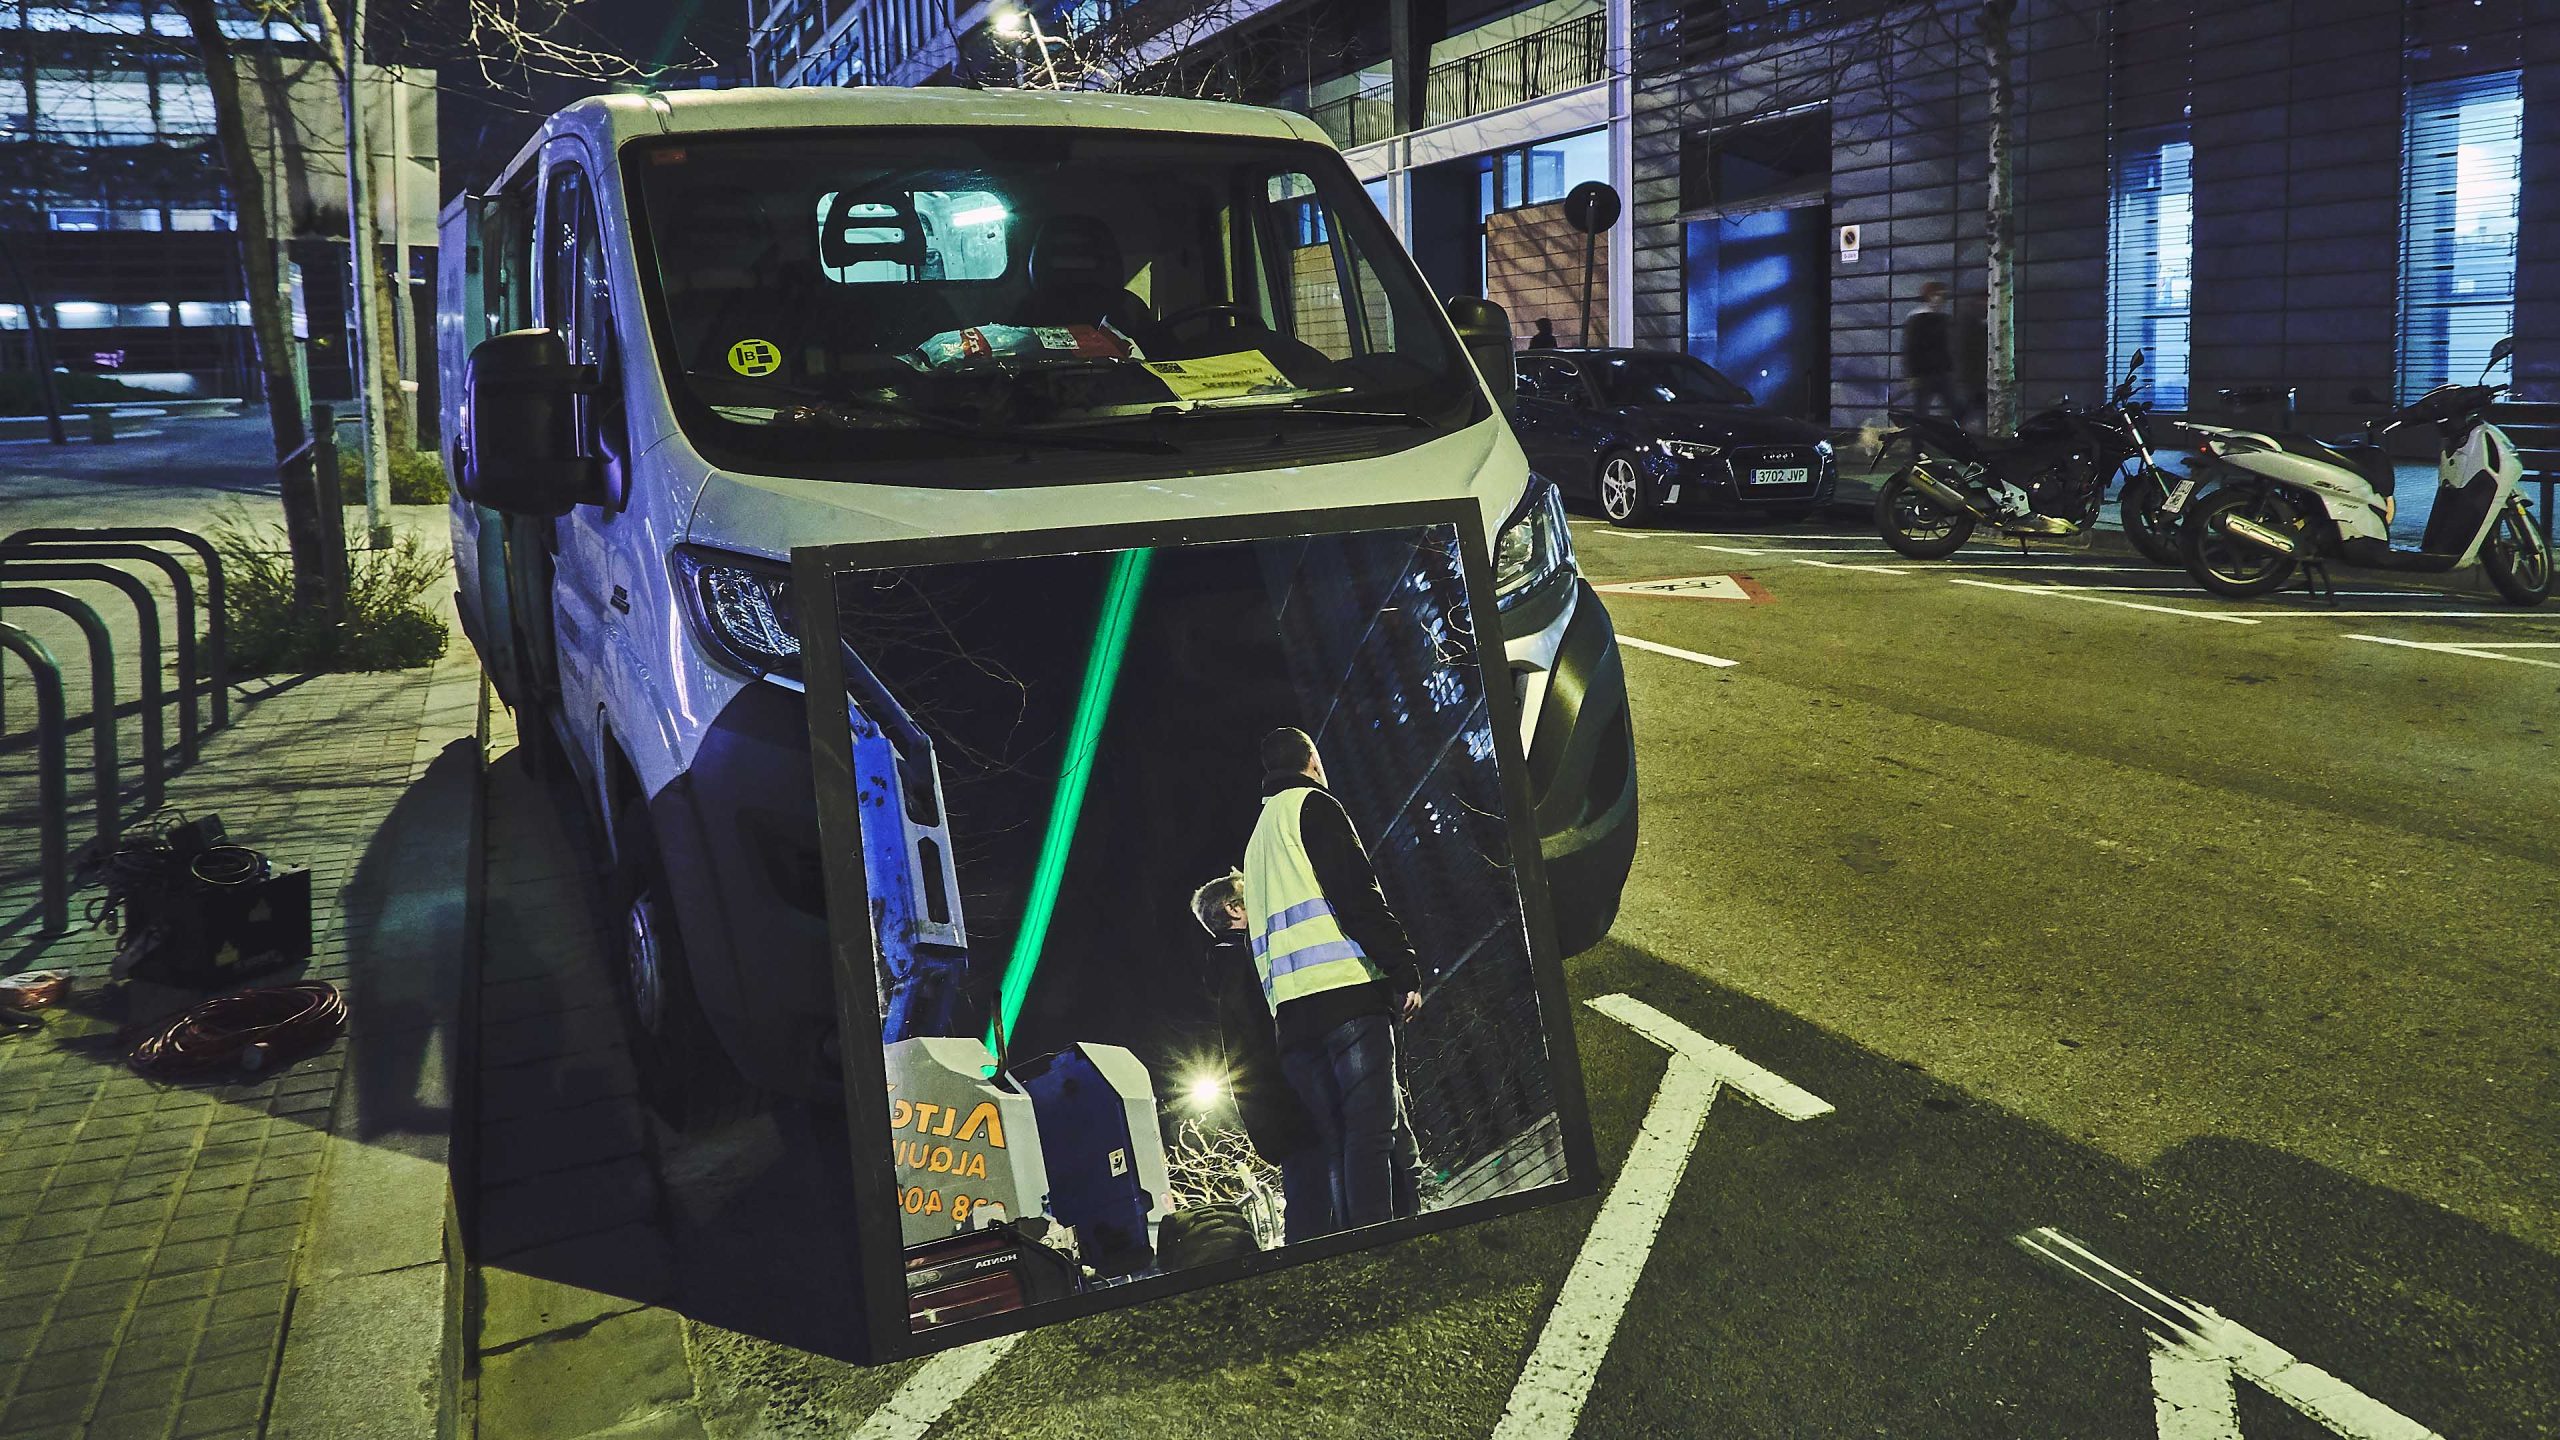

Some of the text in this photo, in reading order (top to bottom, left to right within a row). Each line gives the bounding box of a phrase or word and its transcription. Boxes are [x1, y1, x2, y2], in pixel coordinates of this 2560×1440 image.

[744, 351, 755, 361] B
[1759, 469, 1805, 483] 3702 JVP
